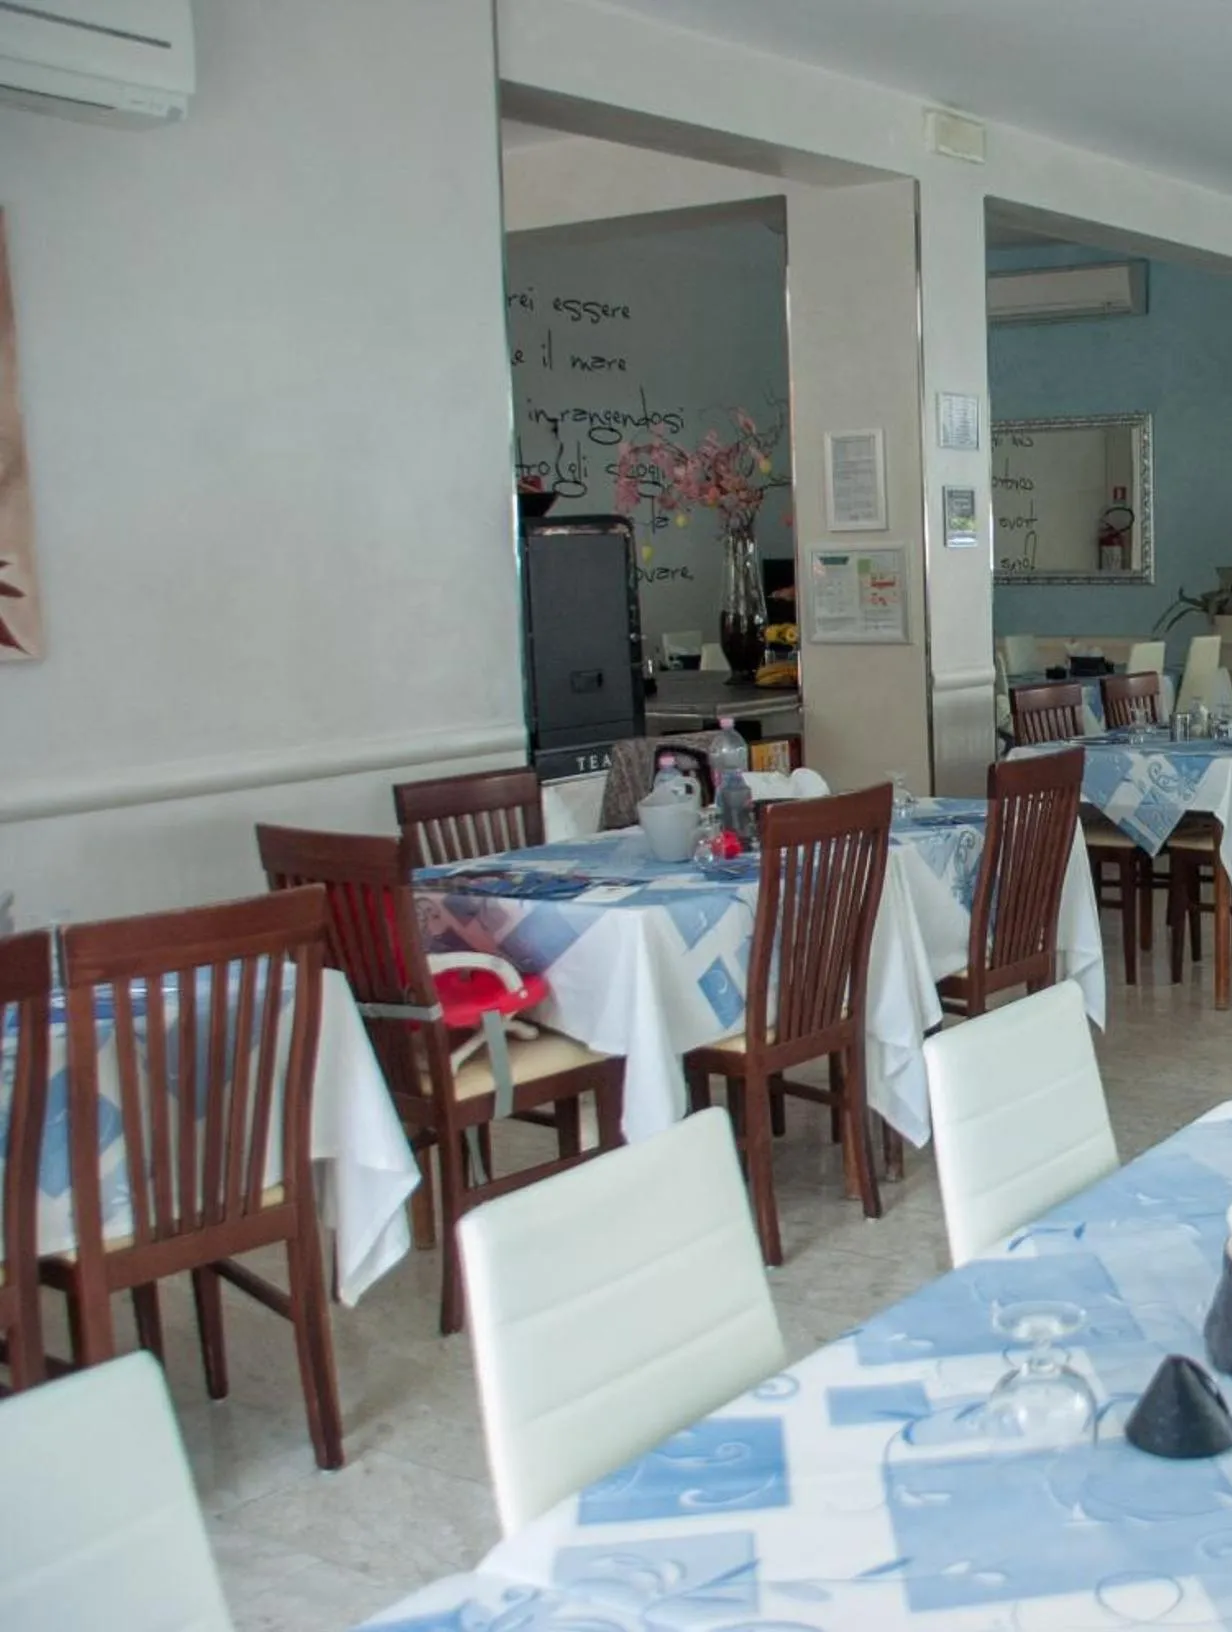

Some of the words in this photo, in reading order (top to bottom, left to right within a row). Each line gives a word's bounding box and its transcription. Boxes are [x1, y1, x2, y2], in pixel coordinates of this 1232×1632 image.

[507, 287, 534, 311] rei
[552, 296, 631, 323] essere
[541, 327, 552, 370] il
[571, 354, 628, 372] mare
